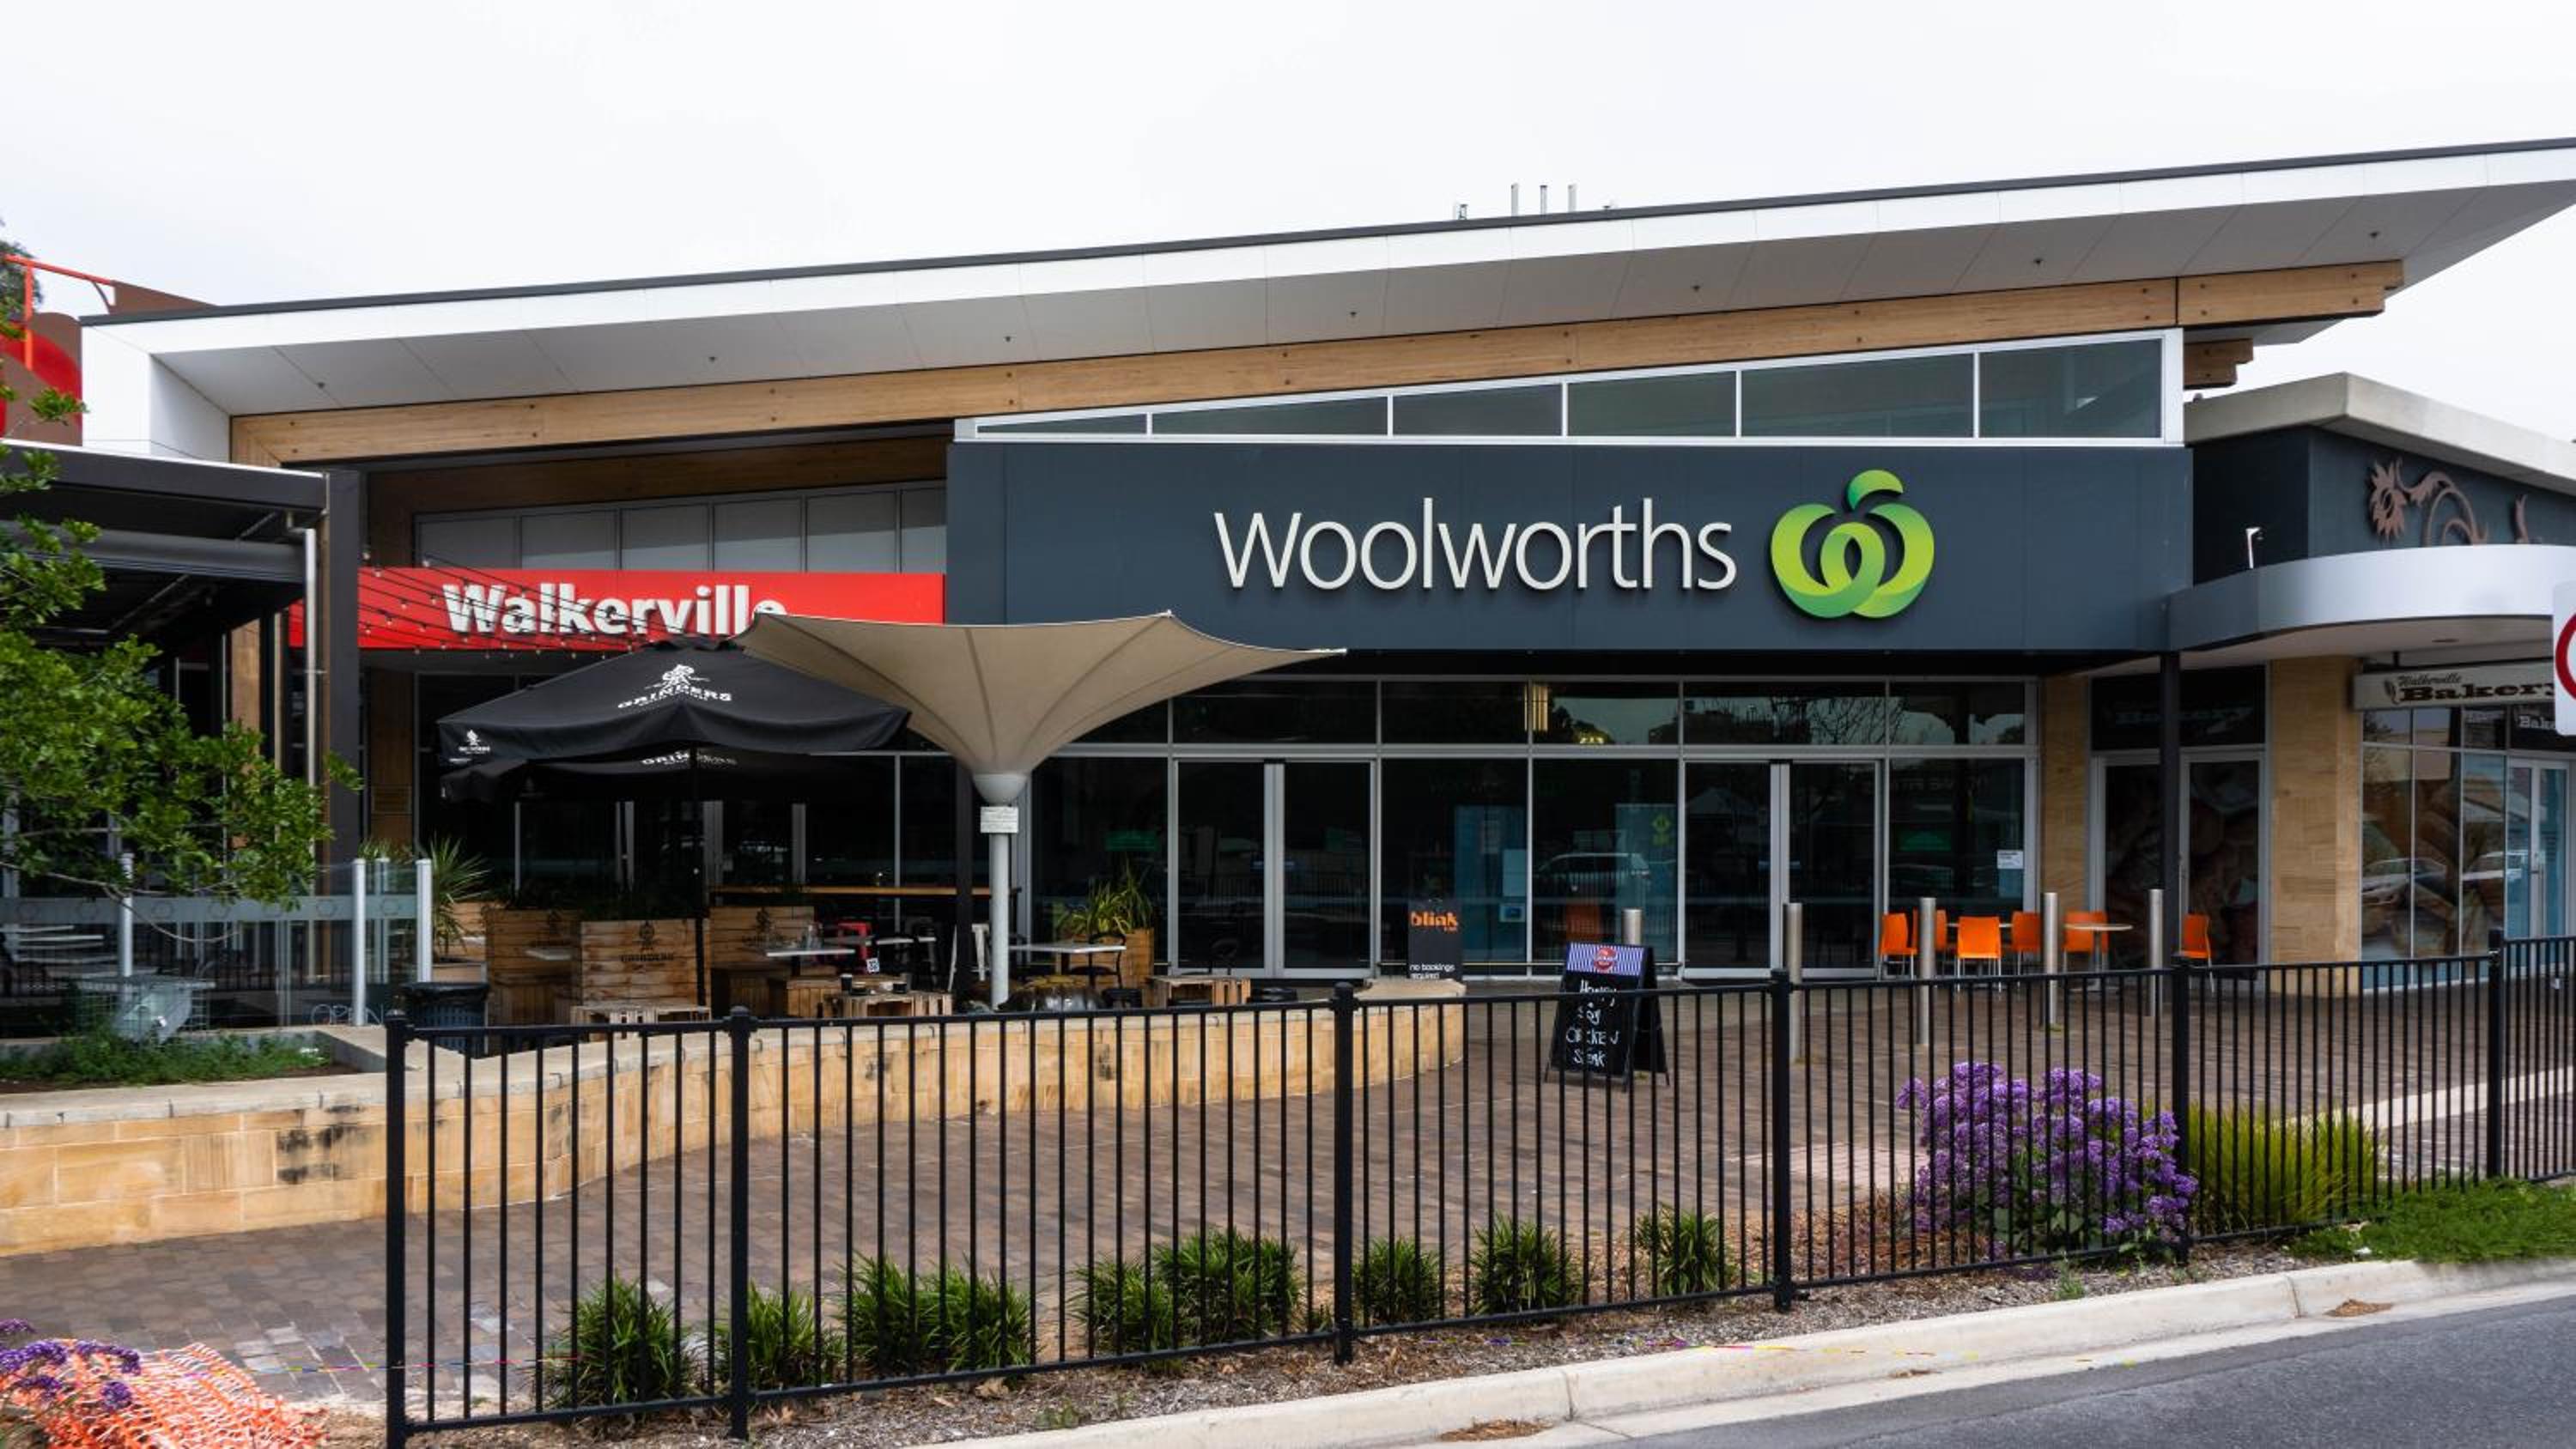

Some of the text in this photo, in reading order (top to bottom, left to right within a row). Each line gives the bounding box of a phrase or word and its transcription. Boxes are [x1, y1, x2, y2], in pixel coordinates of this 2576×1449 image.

[1214, 497, 1737, 590] Woolworths
[1410, 911, 1458, 927] blink
[311, 1003, 384, 1026] OPN
